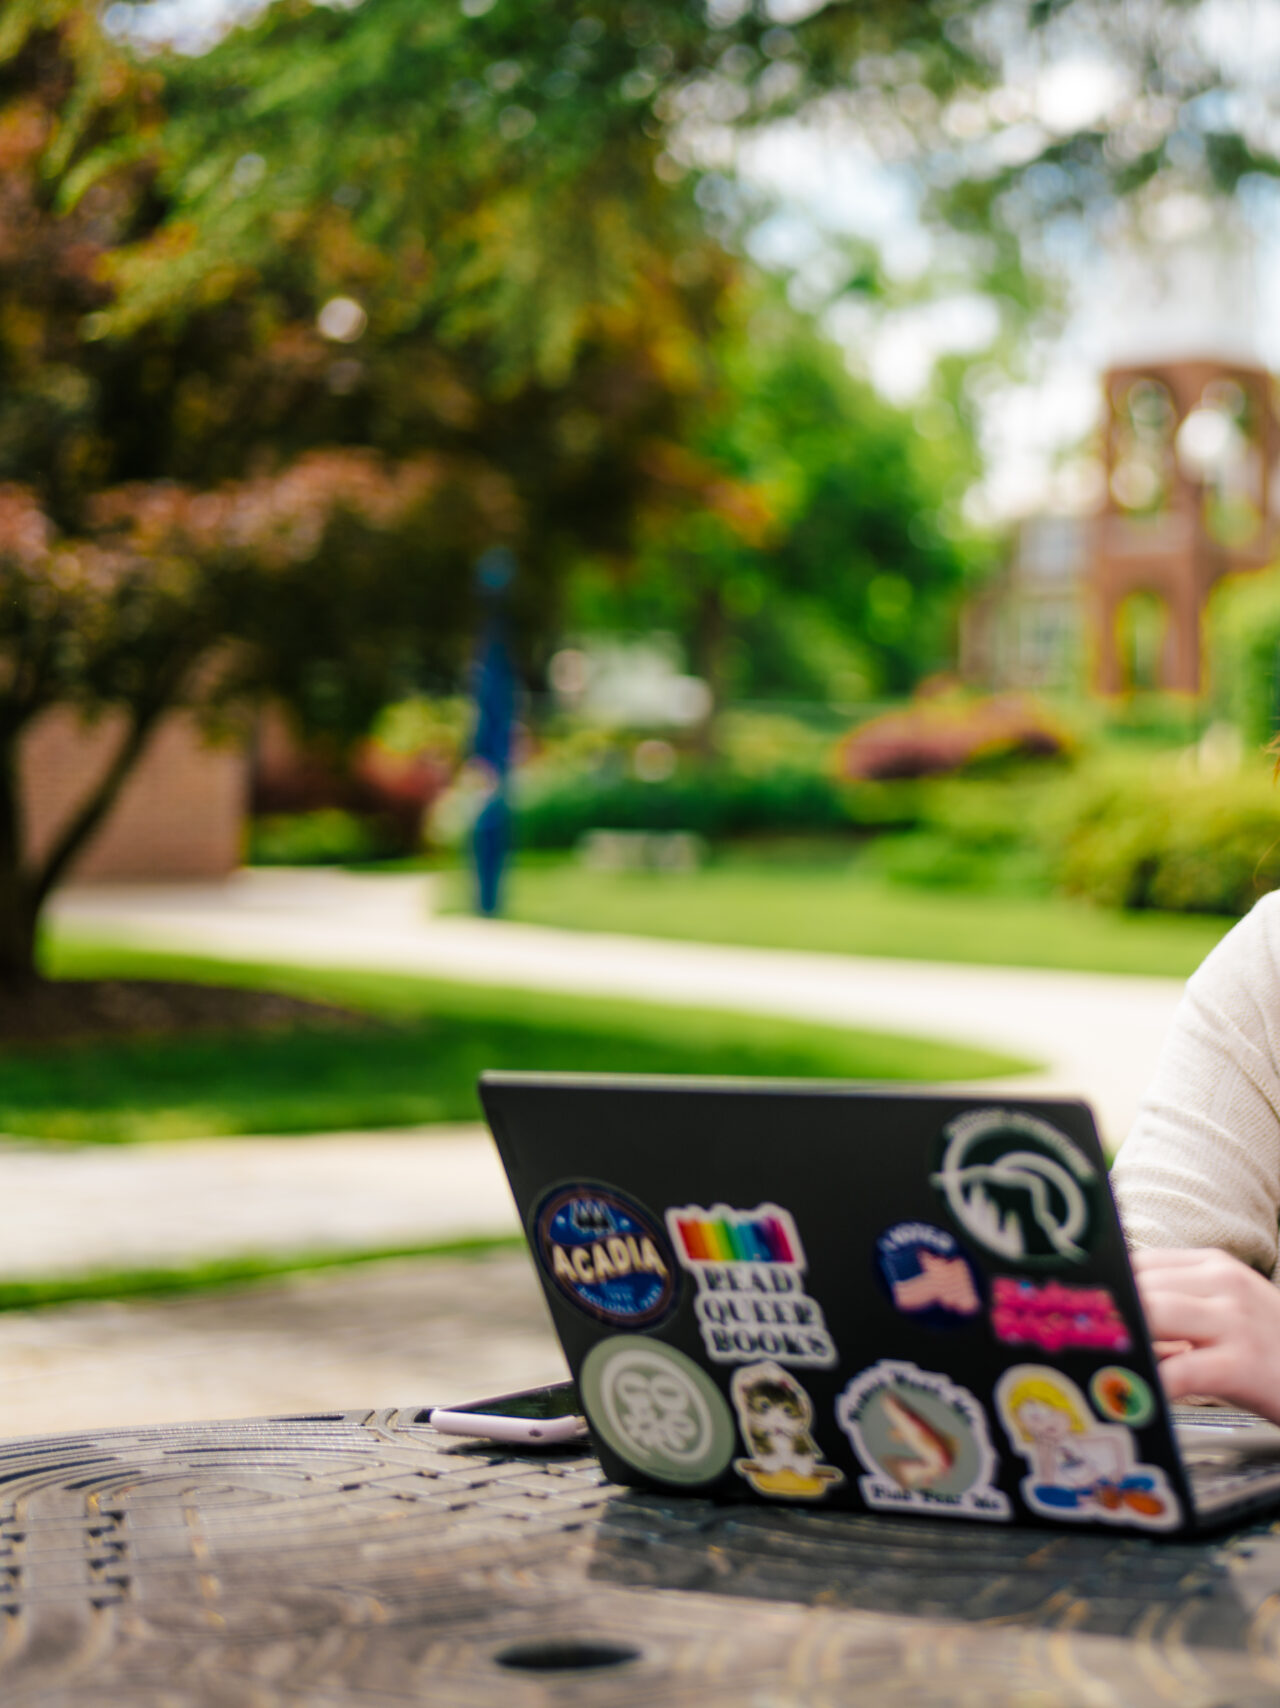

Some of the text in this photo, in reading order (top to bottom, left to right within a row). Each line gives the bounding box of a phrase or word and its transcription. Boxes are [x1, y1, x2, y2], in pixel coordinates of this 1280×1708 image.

[552, 1236, 669, 1284] ACADIA
[704, 1267, 794, 1293] READ
[704, 1299, 814, 1326] QUEER
[711, 1329, 828, 1357] BOOKS
